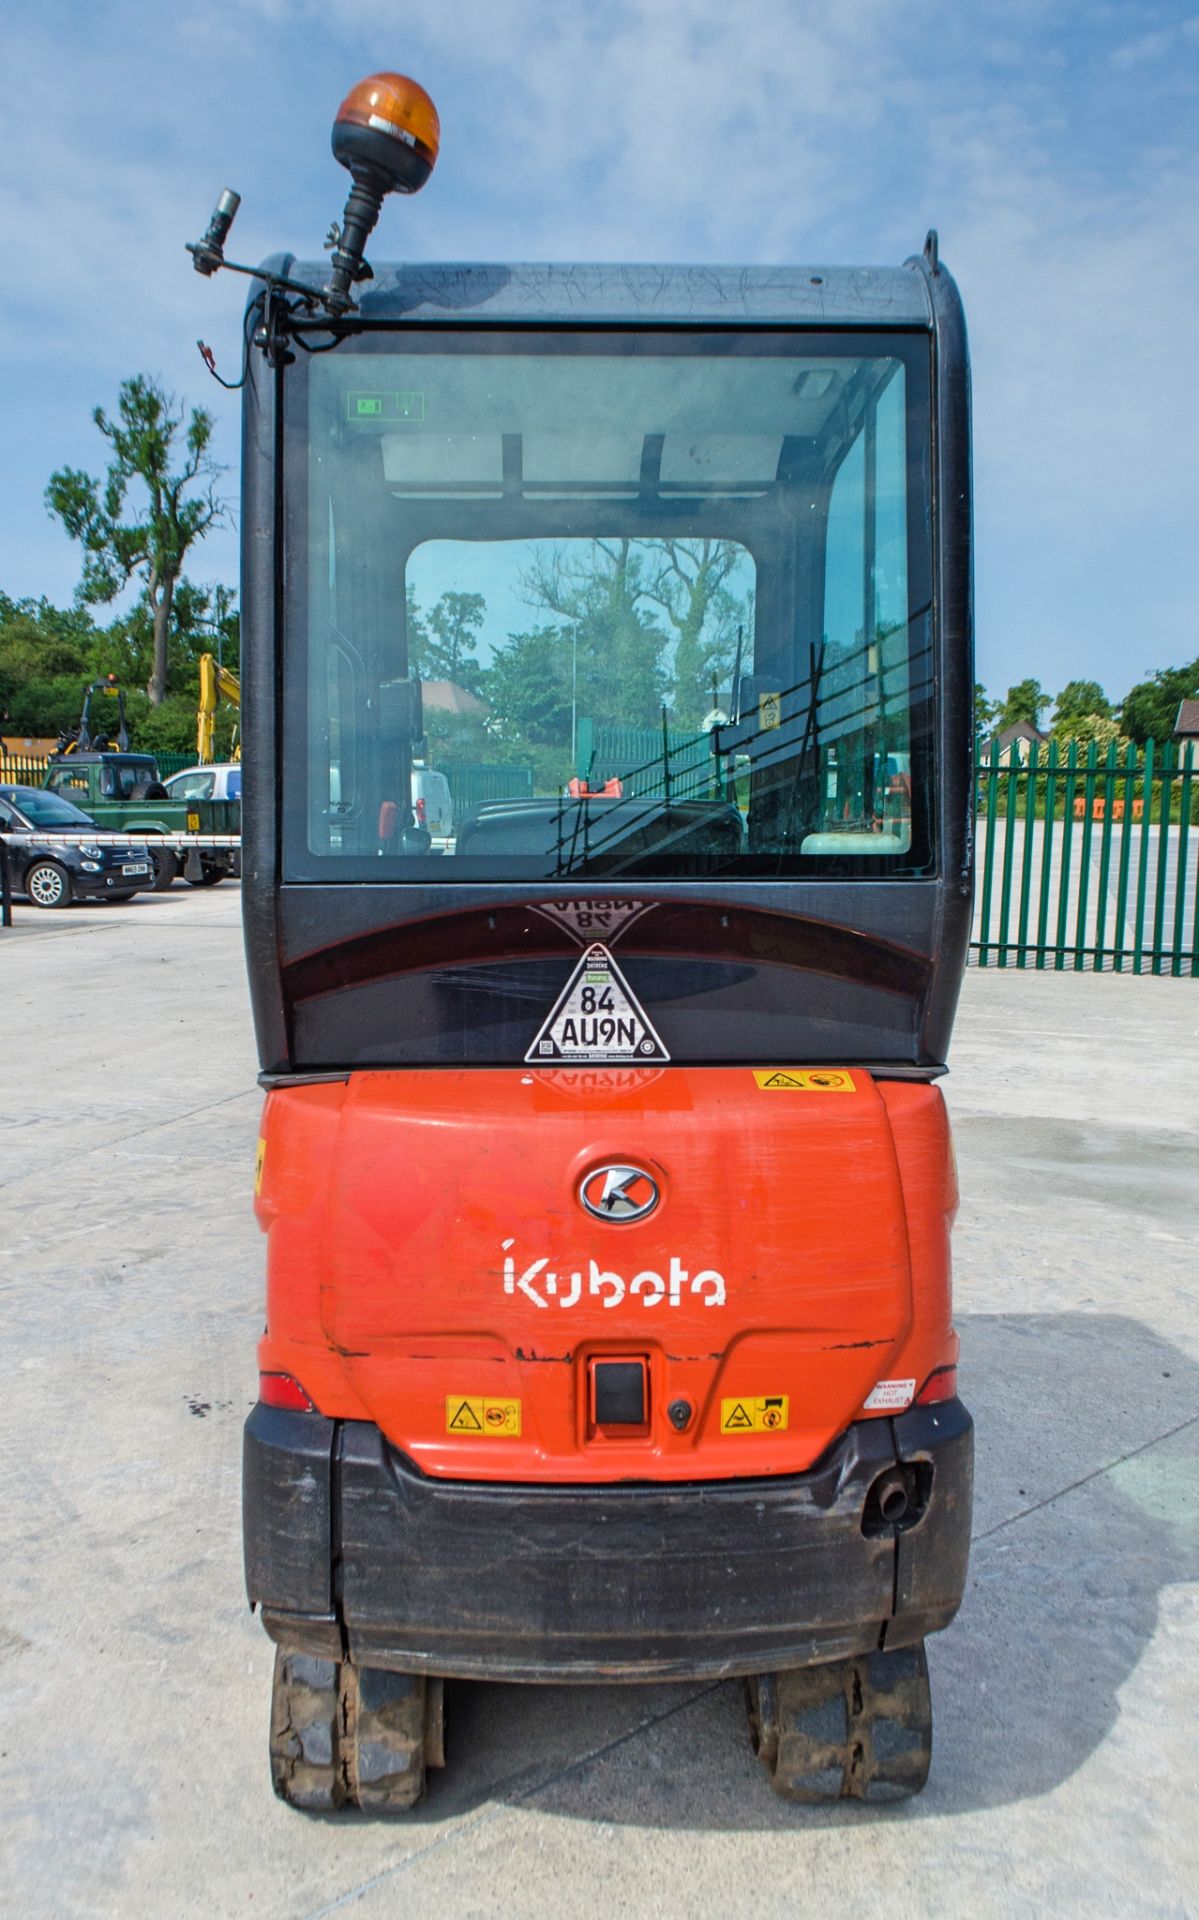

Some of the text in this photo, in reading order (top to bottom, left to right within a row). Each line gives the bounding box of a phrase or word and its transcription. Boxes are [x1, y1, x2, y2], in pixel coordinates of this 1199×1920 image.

[580, 986, 615, 1015] 84
[561, 1018, 636, 1047] AU9N
[501, 1238, 727, 1309] Kubota
[876, 1382, 908, 1390] WARNING
[873, 1397, 904, 1405] EXHAUST
